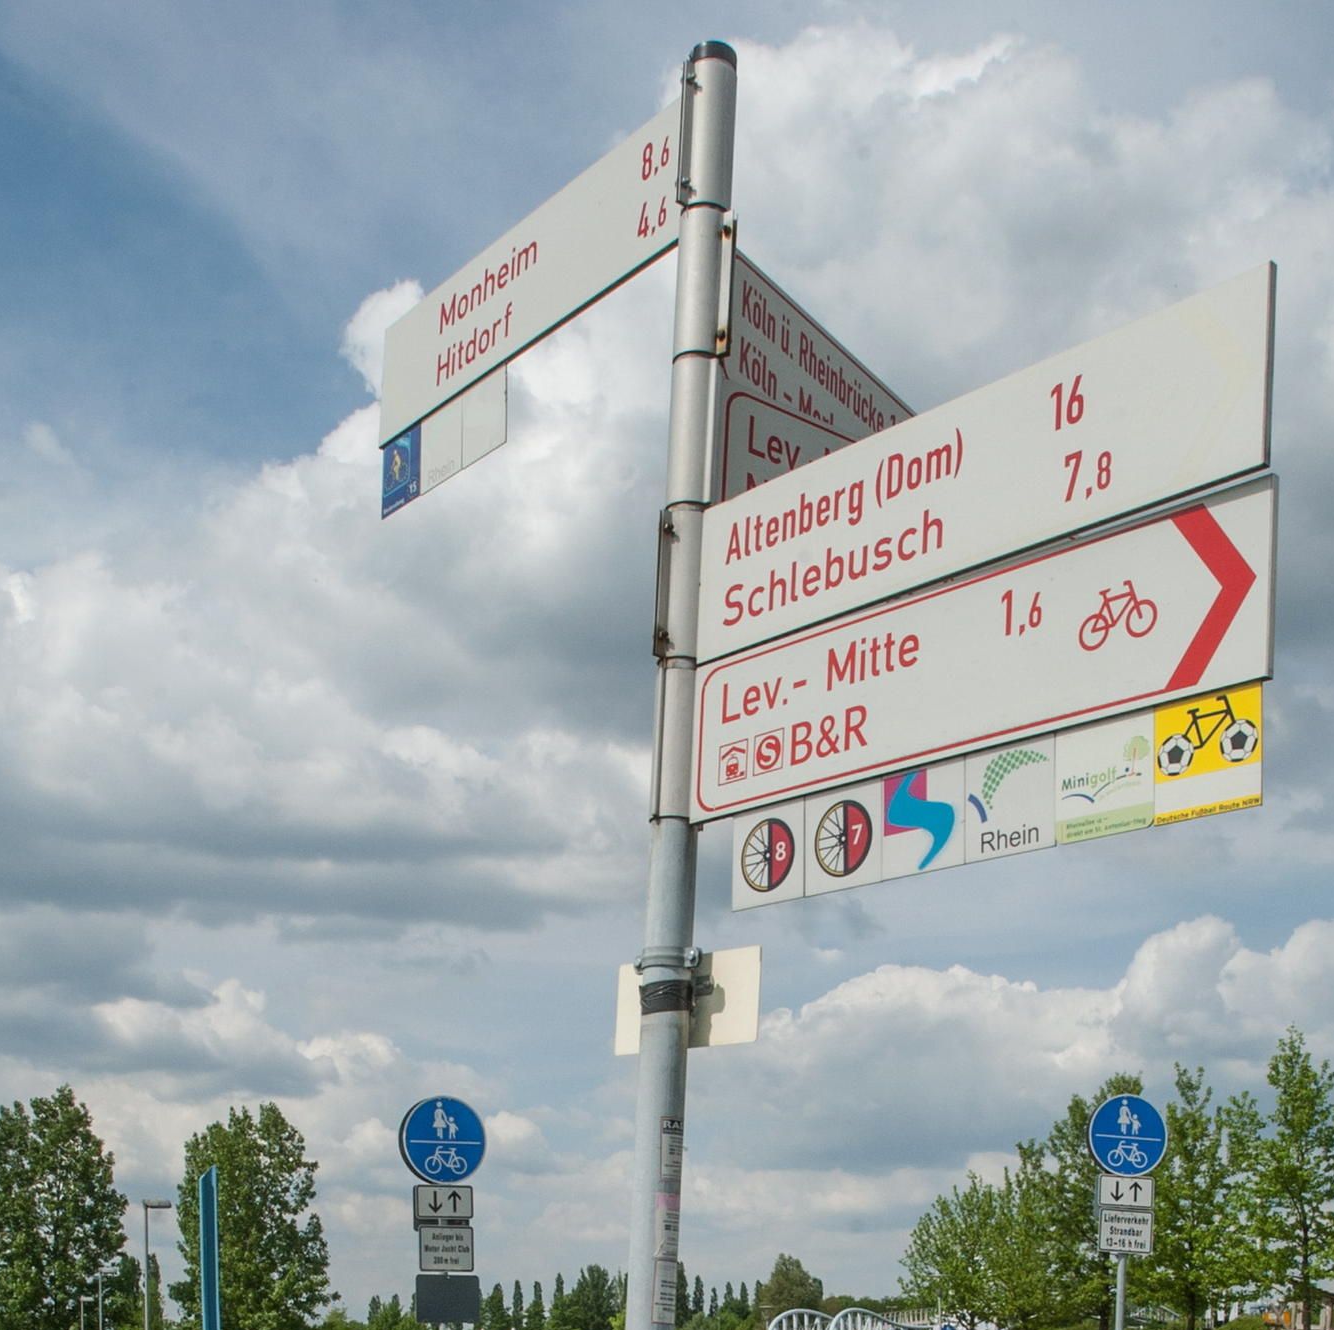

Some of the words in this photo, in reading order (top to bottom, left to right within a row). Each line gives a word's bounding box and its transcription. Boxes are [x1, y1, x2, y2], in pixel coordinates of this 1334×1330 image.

[439, 241, 538, 335] Monheim
[641, 135, 670, 181] 8,6
[435, 301, 513, 388] Hitdorf
[636, 195, 667, 238] 4,6
[739, 336, 777, 401] Köln
[741, 279, 776, 344] Köln
[780, 314, 794, 360] ü.
[799, 330, 884, 433] Rheinbrücke
[724, 478, 865, 566] Altenberg
[874, 426, 963, 509] (Dom)
[1050, 373, 1085, 432] 16
[722, 508, 944, 627] Schlebusch
[1064, 449, 1112, 503] 7,8
[826, 631, 920, 692] Mitte
[1001, 588, 1043, 637] 1,6
[789, 704, 868, 767] B&R
[1061, 766, 1117, 792] Minigolf
[1156, 812, 1189, 824] Deutsche
[1191, 805, 1217, 817] Fußball
[1219, 802, 1240, 811] Route
[1242, 798, 1260, 807] NRW
[850, 823, 863, 847] 7
[979, 824, 1040, 855] Rhein
[775, 840, 787, 863] 8
[1104, 1213, 1149, 1225] Lieferverkehr
[1109, 1225, 1143, 1237] Strandbar
[458, 1244, 470, 1253] Club
[1127, 1239, 1132, 1248] h
[1134, 1239, 1147, 1249] frei
